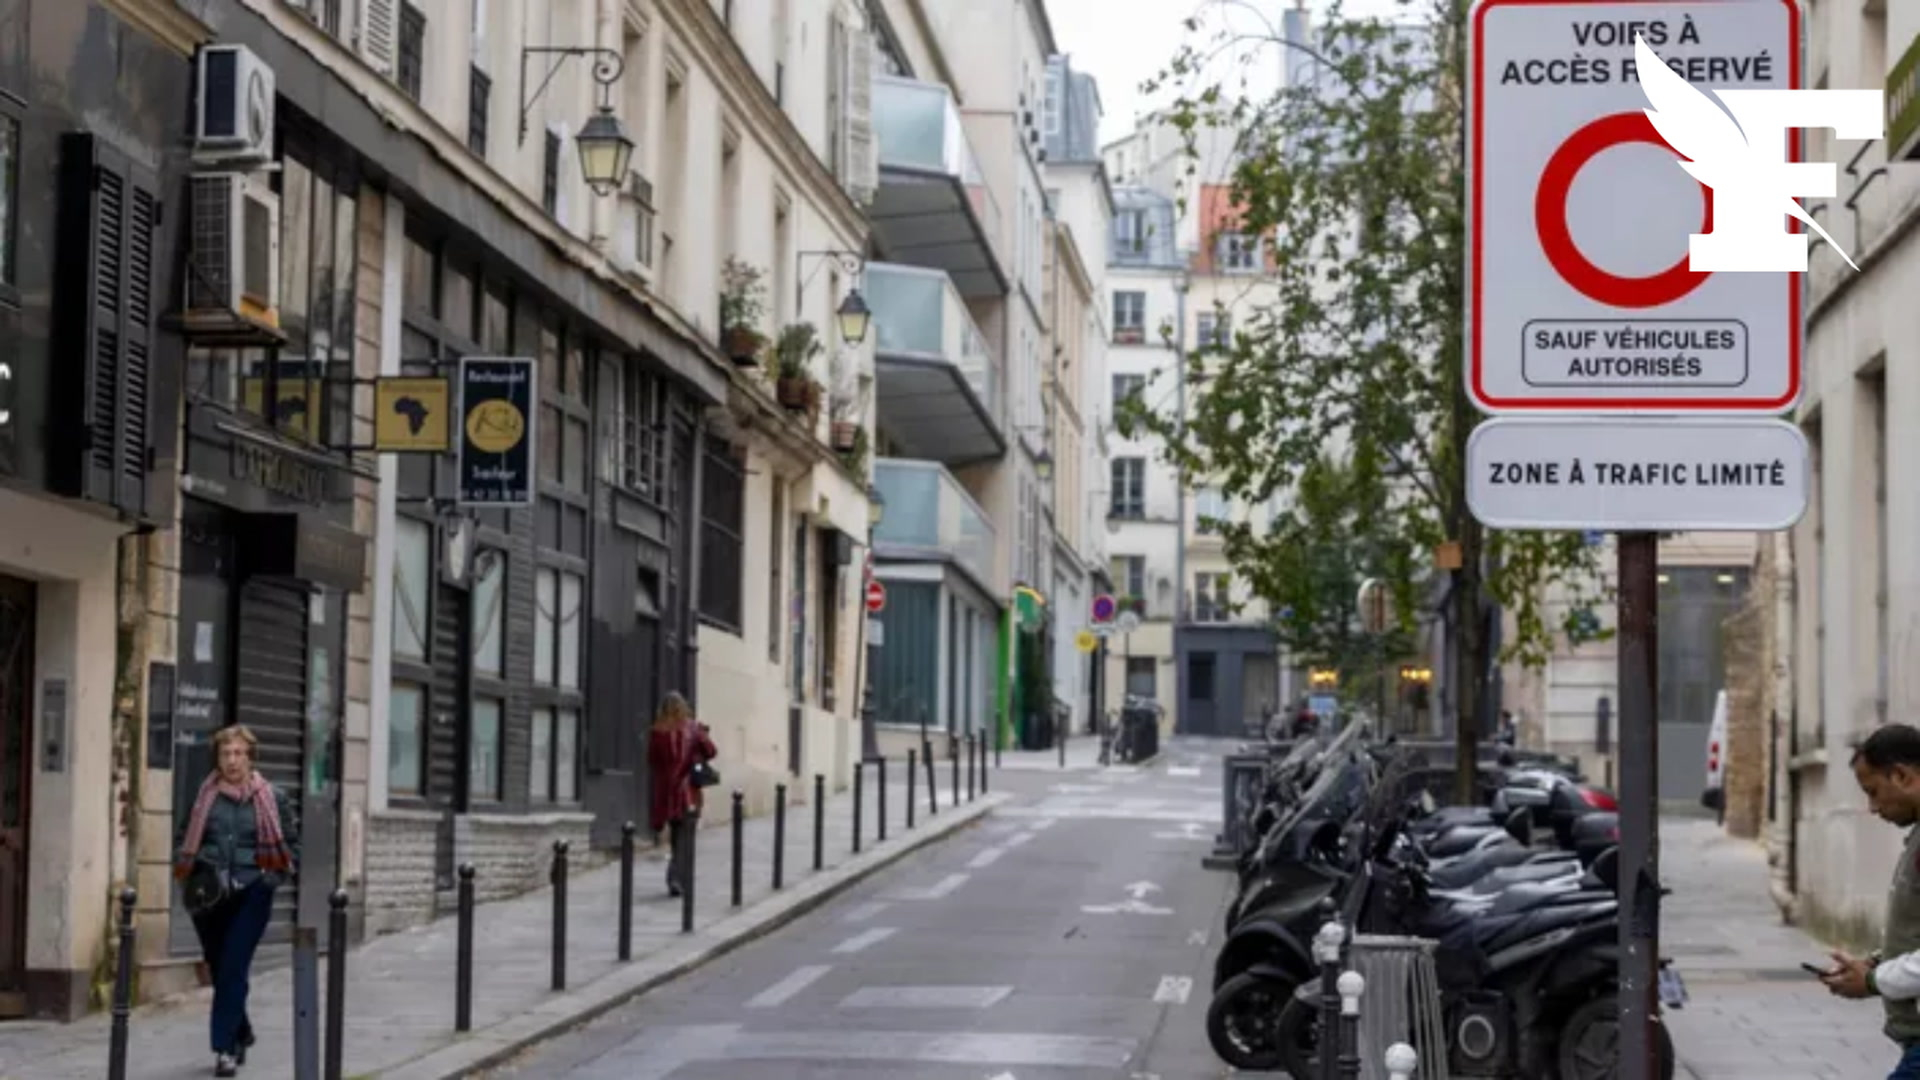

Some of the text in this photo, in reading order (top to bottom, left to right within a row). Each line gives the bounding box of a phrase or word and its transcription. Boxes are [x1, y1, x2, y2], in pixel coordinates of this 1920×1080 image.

[1572, 13, 1700, 47] VOIES À
[1501, 50, 1773, 85] ACCÈS RSERVÉ
[1535, 326, 1735, 350] SAUF VÉHICULES
[1568, 353, 1702, 377] AUTORISÉS
[1489, 458, 1785, 486] ZONE À TRAFIC LIMITÉ
